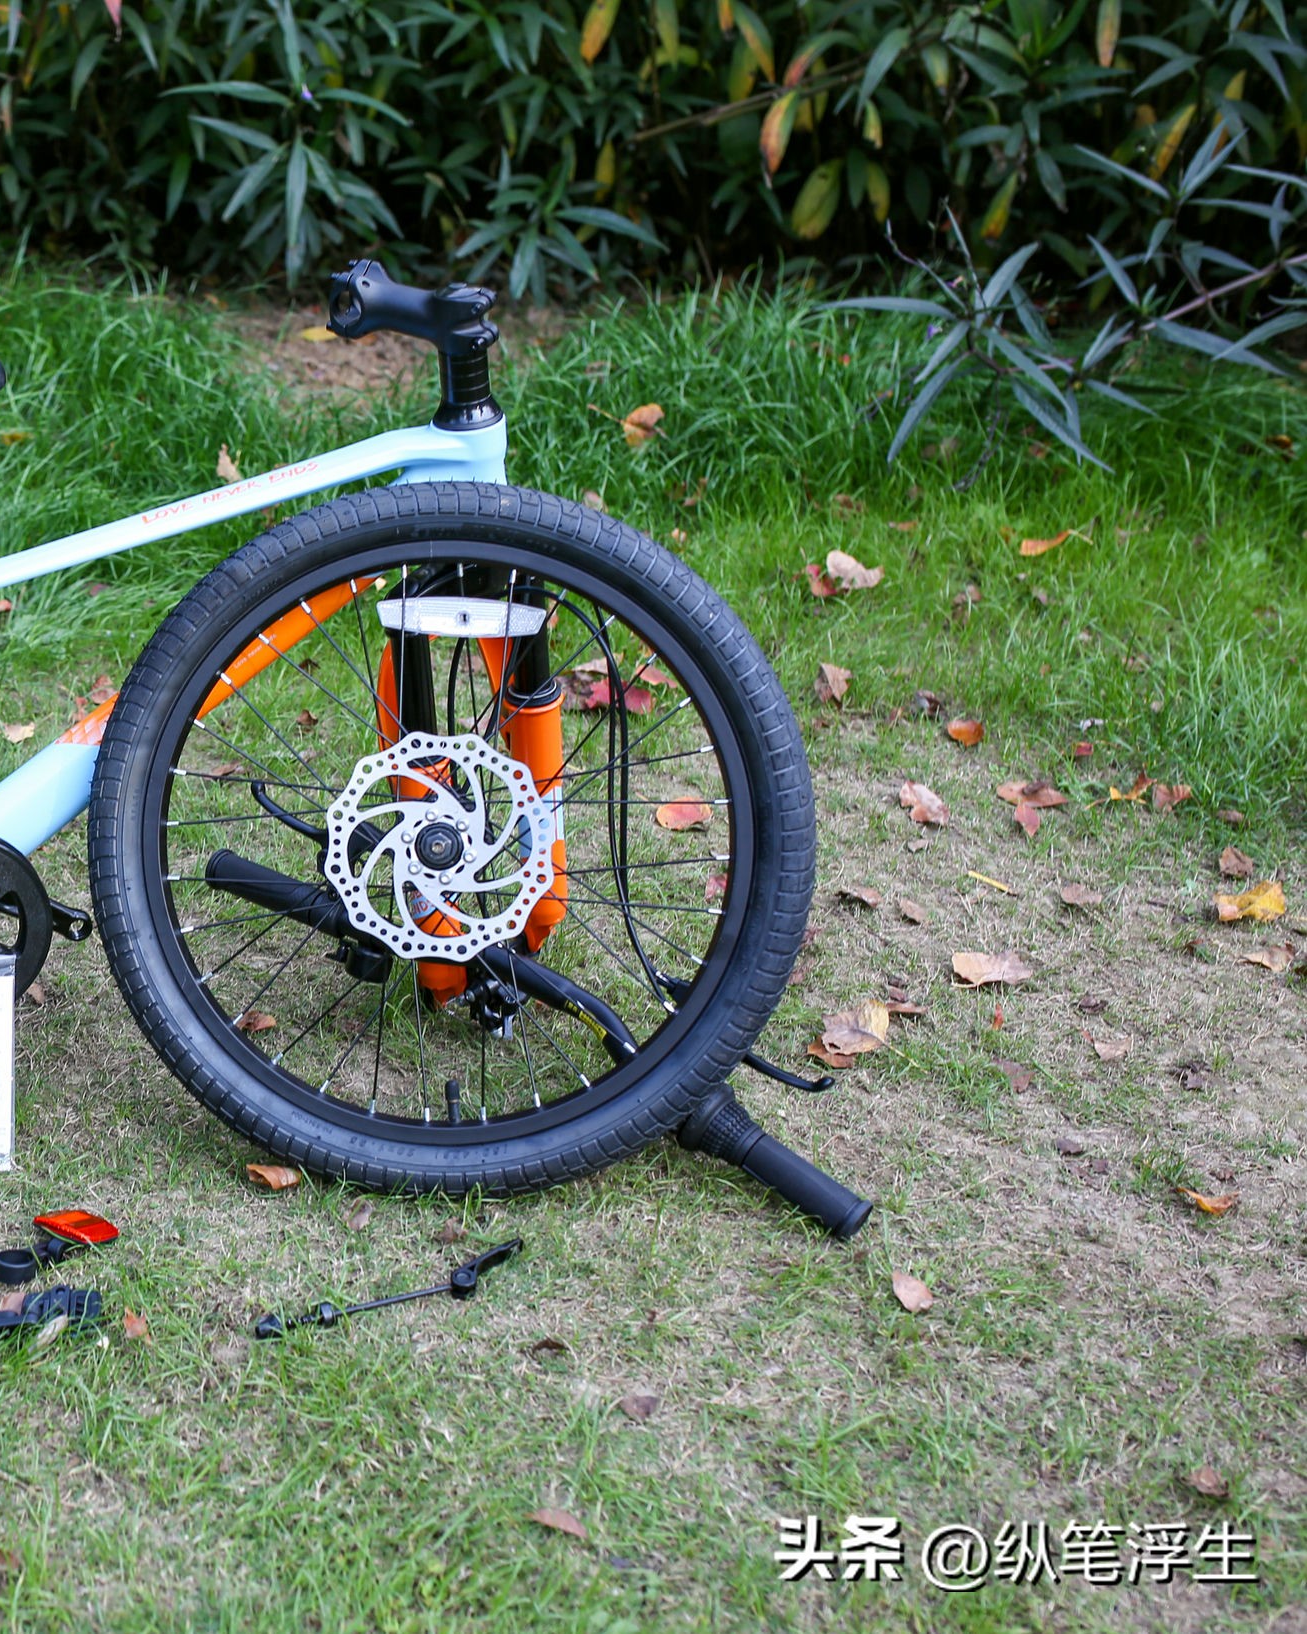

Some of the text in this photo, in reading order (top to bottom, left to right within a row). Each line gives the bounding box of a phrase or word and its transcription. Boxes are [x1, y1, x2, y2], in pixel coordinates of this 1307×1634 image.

[141, 461, 319, 524] LOVE NEVER ENDS
